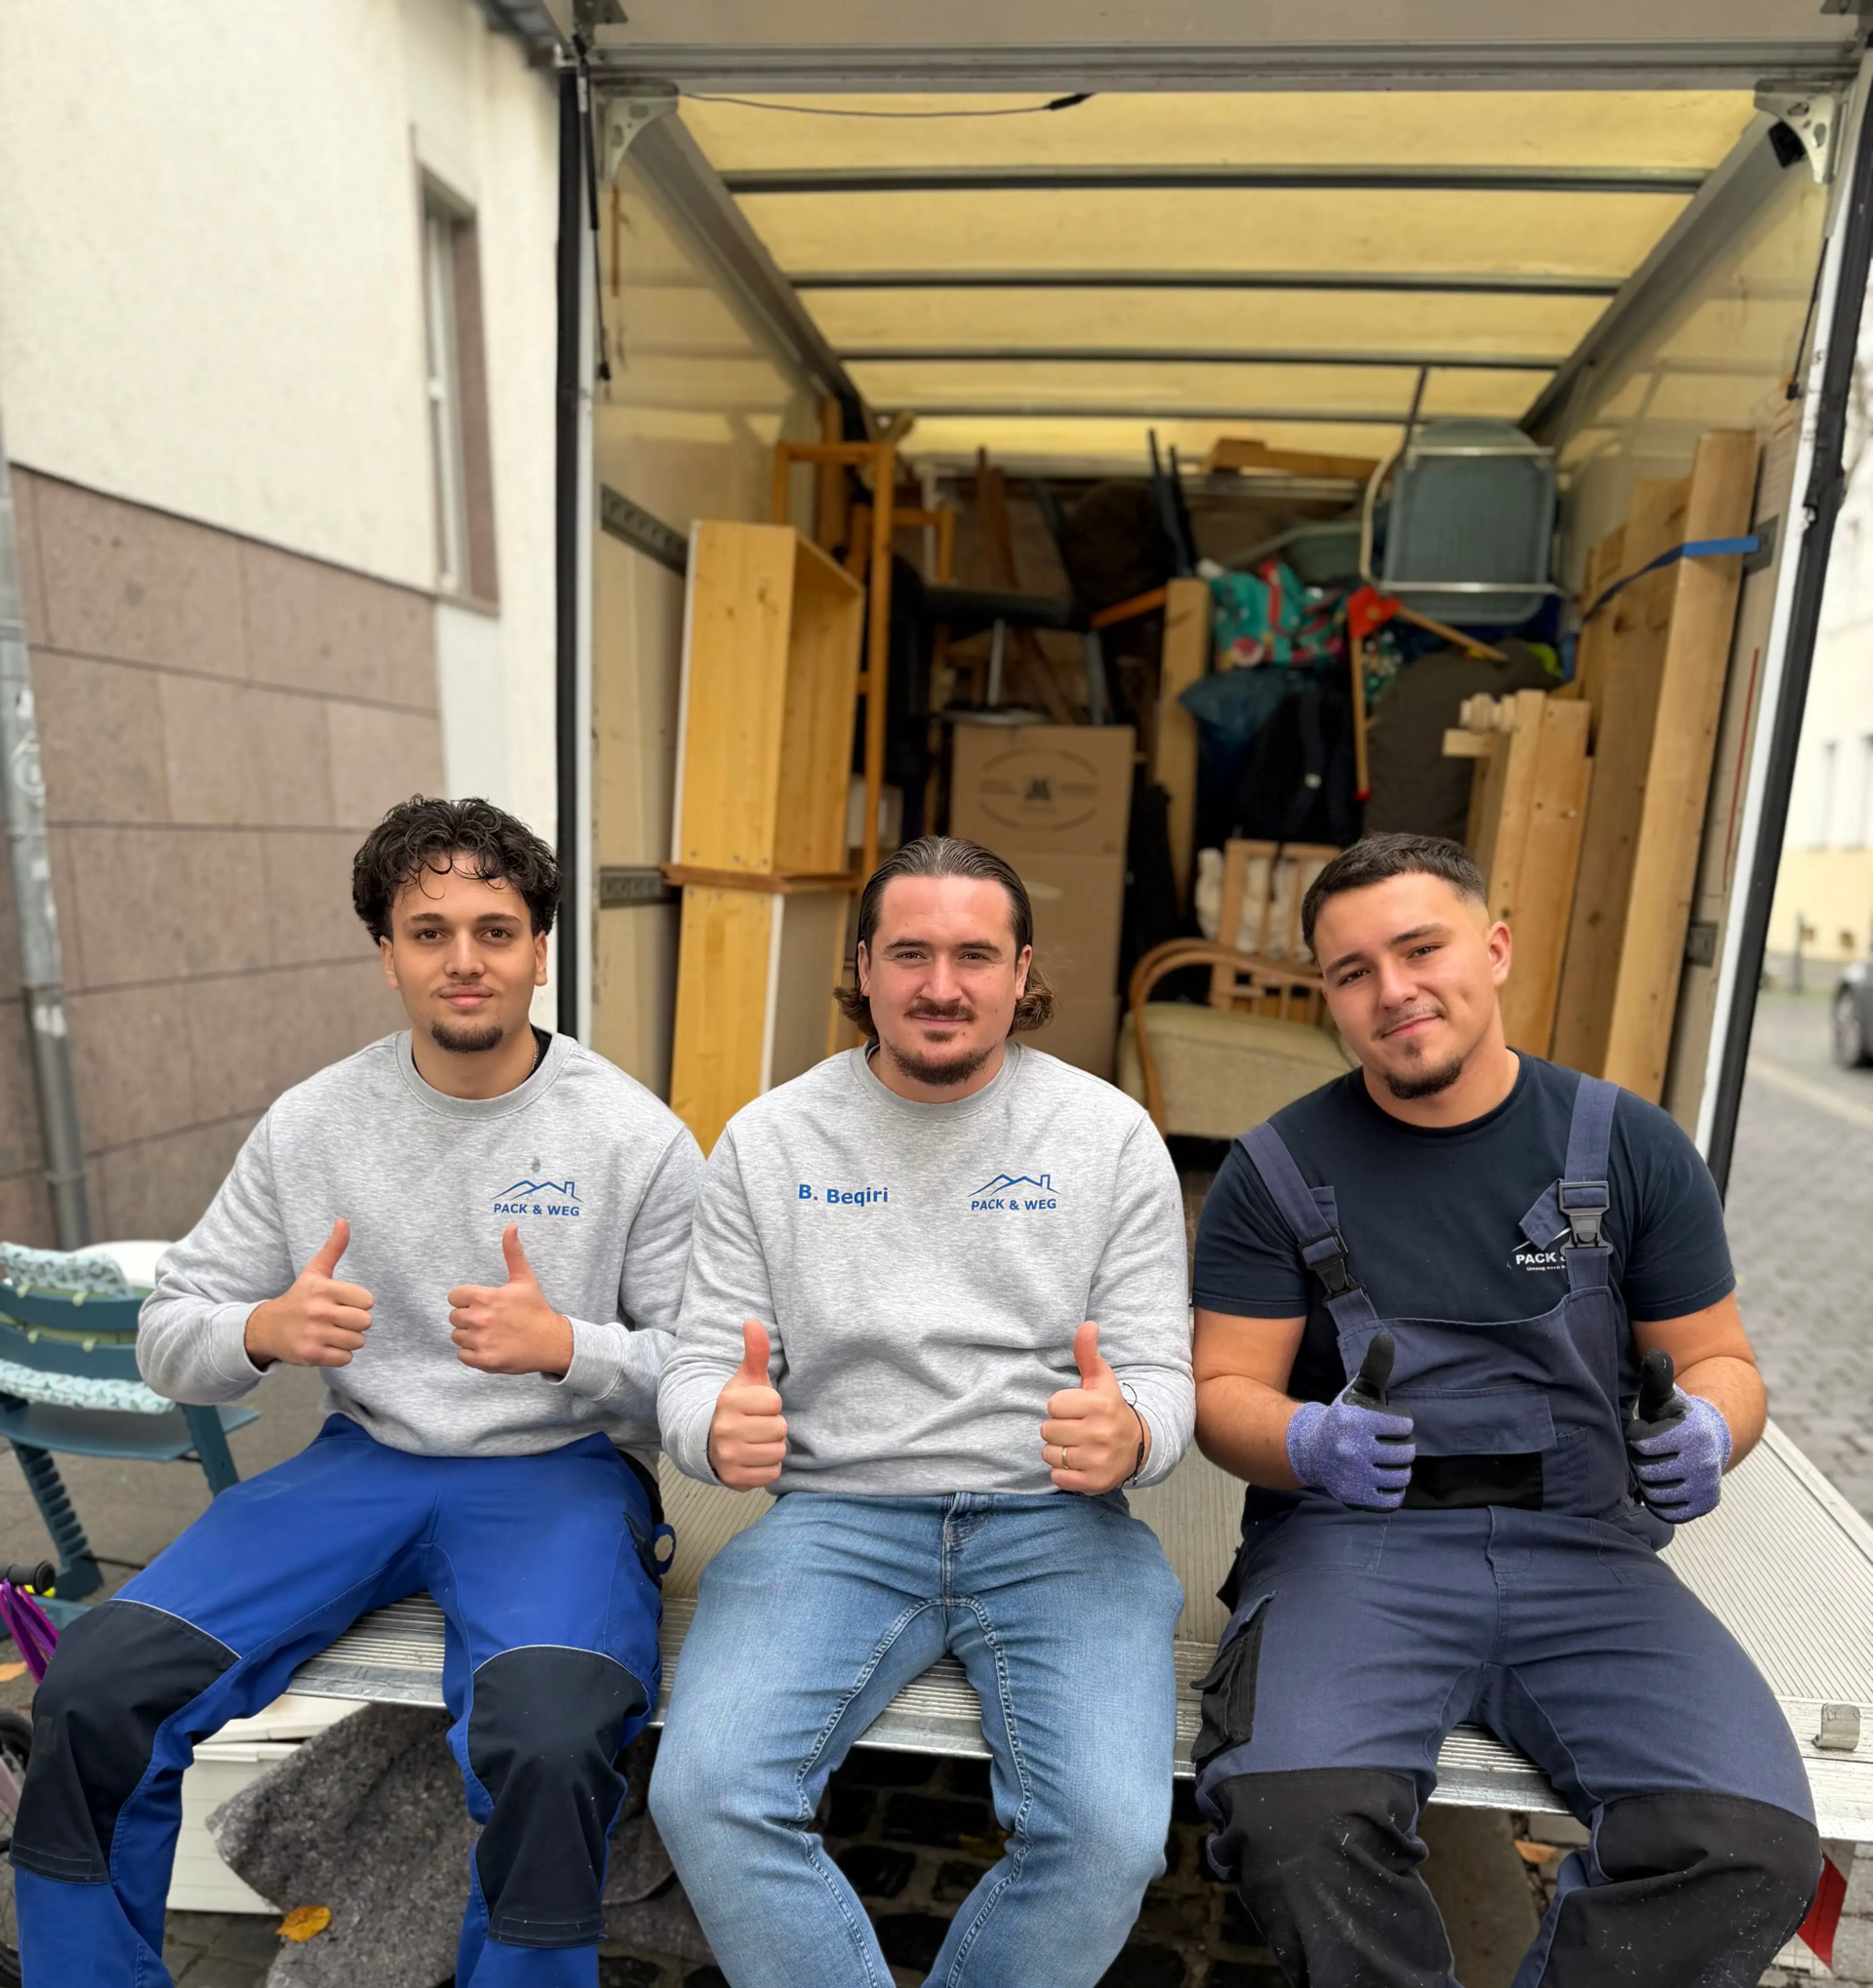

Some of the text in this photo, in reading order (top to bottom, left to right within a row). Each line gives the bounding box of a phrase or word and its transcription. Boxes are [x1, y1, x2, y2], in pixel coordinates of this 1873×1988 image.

[798, 1183, 888, 1208] B. Beqiri
[494, 1203, 580, 1216] PACK & WEG
[971, 1199, 1057, 1211] PACK & WEG
[1515, 1252, 1557, 1265] PACK
